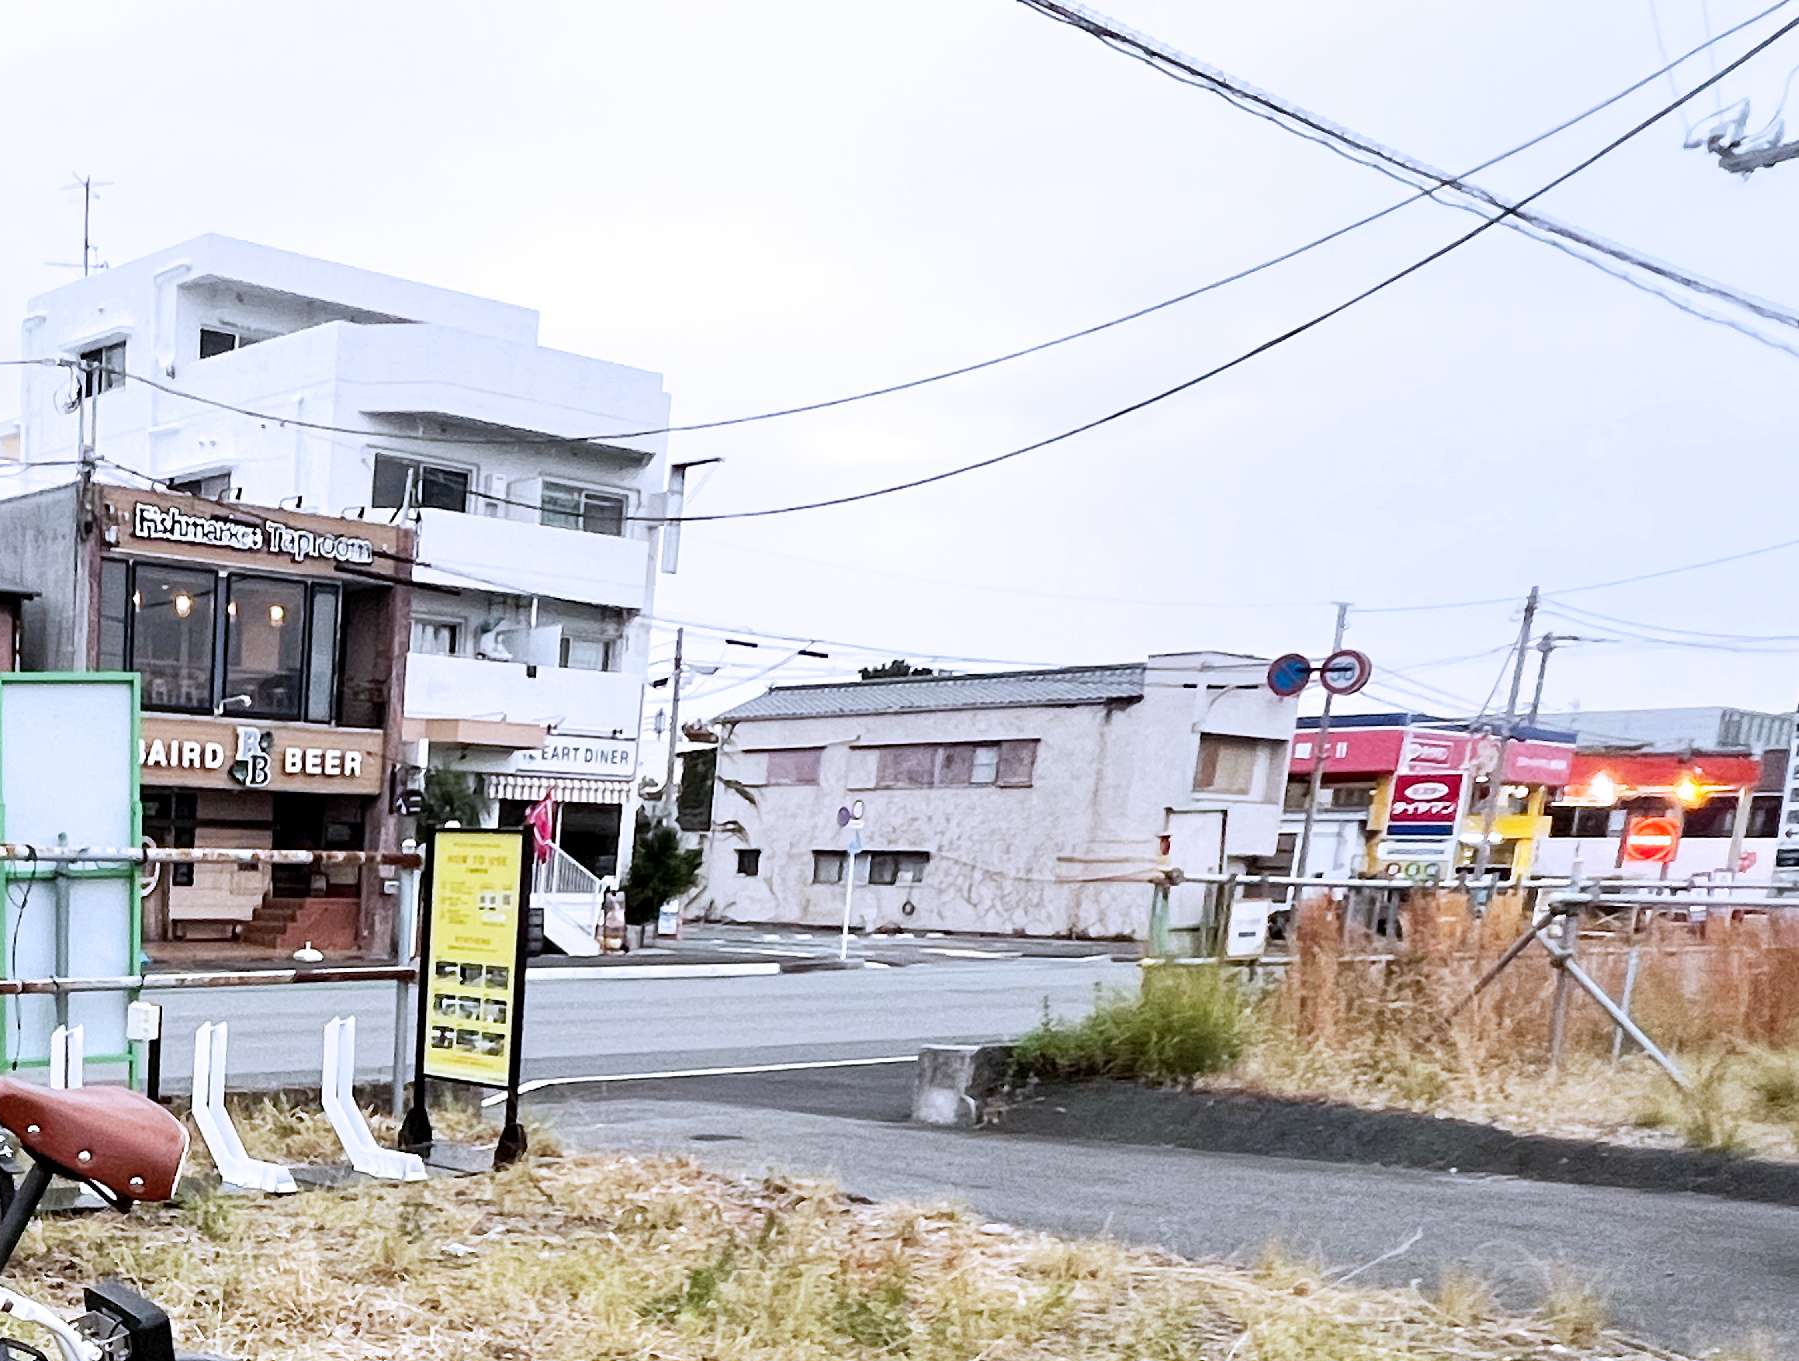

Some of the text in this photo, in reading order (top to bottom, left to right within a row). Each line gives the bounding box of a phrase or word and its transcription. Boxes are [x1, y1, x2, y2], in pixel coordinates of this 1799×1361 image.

[265, 519, 374, 565] Taproom
[284, 747, 364, 778] BEER
[583, 748, 629, 765] DINER
